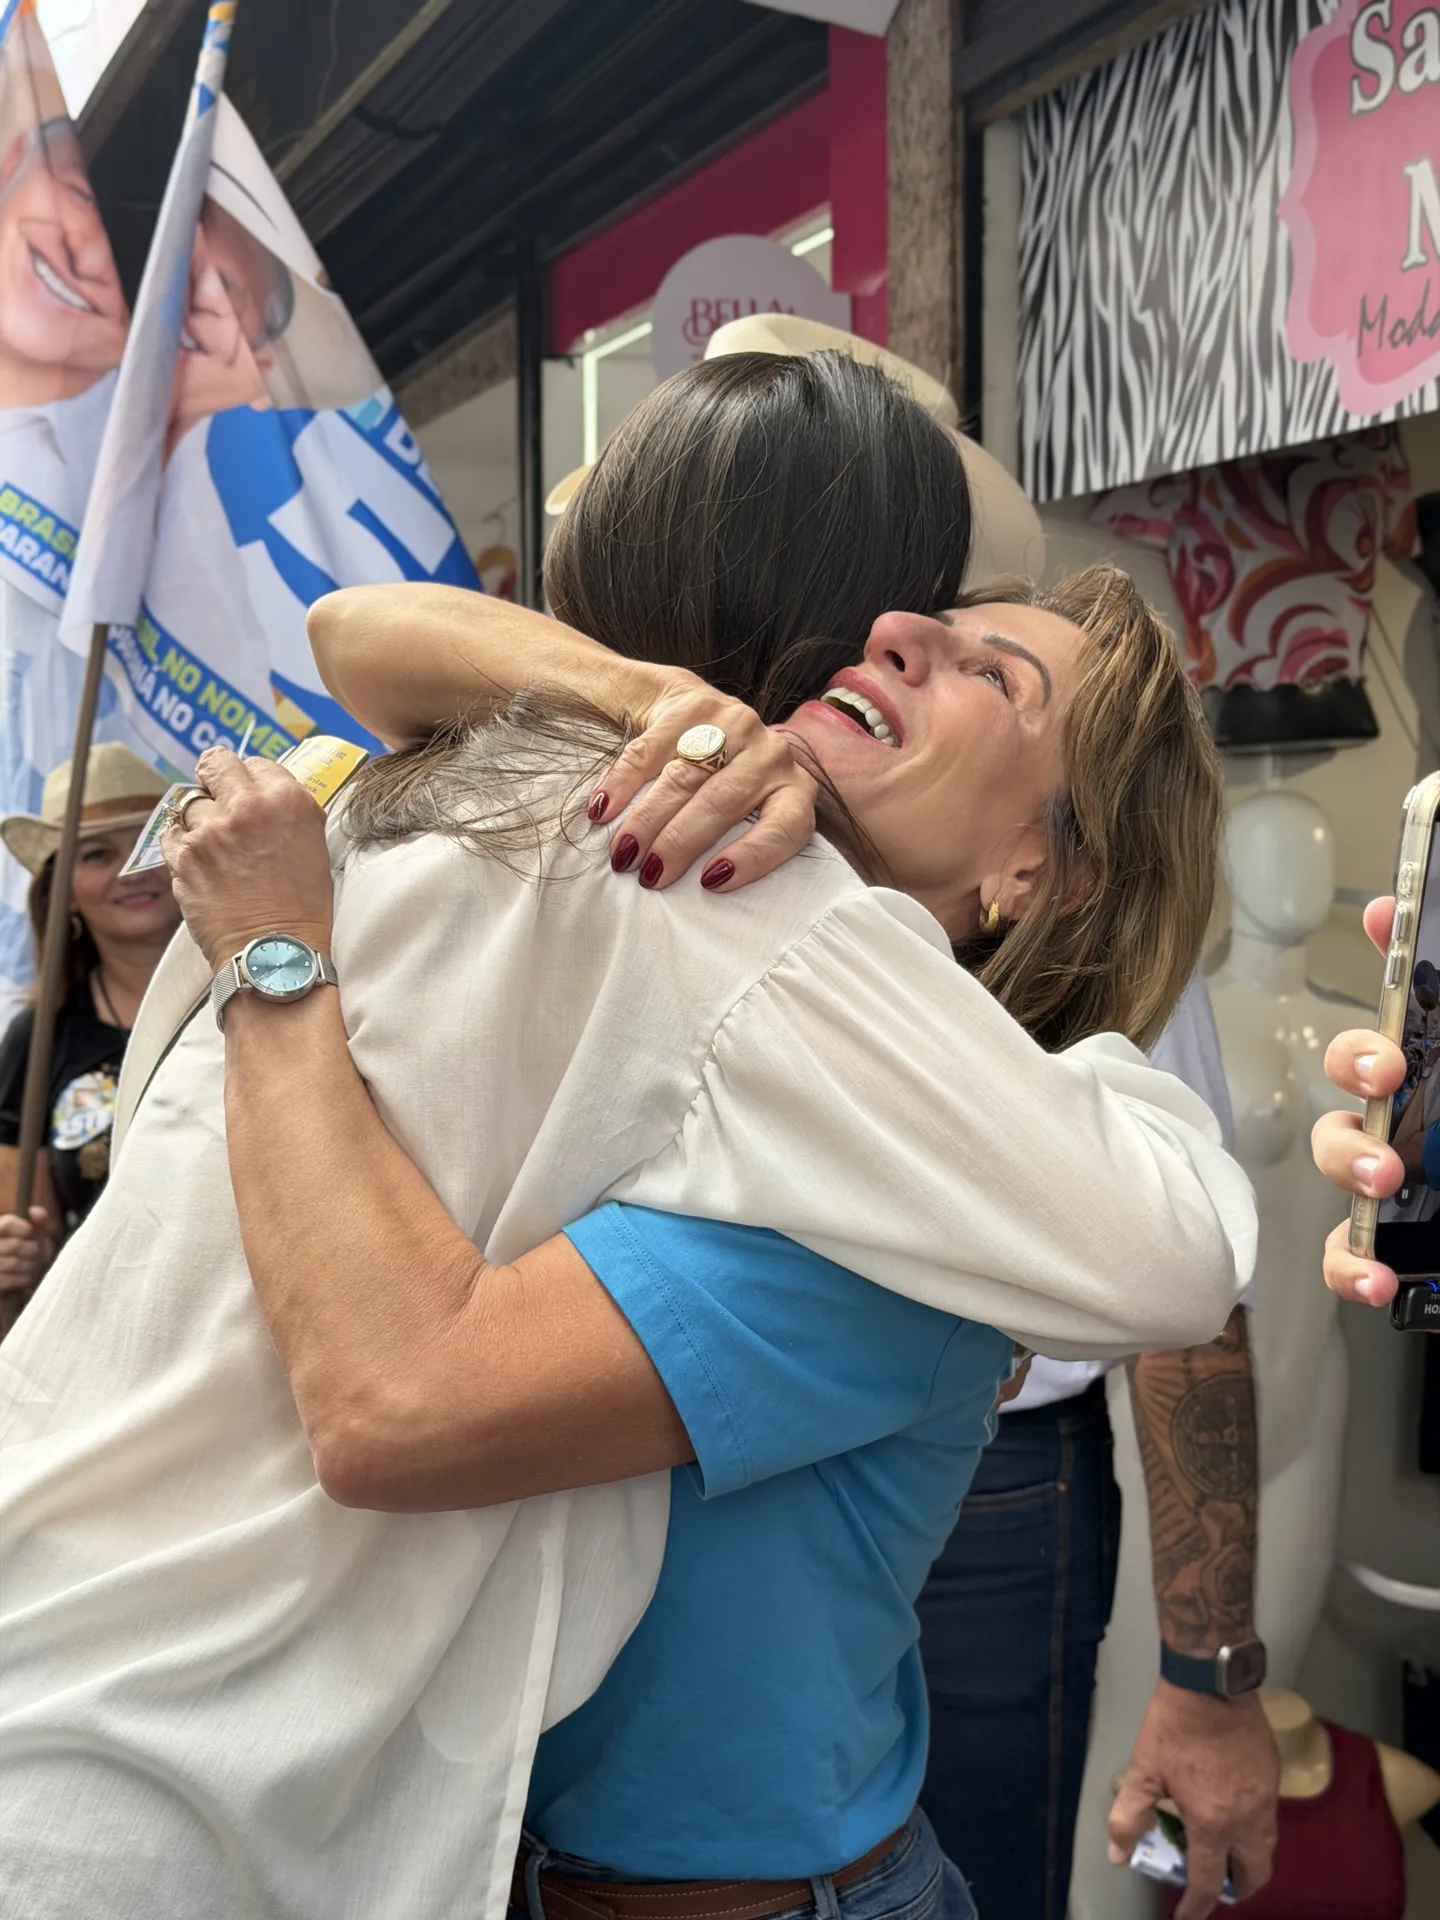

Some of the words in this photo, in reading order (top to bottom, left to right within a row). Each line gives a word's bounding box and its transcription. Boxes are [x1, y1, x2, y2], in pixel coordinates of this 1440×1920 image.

[150, 684, 195, 734] NO
[160, 644, 202, 694] NO
[196, 678, 293, 764] NOME
[1424, 1303, 1440, 1315] HO
